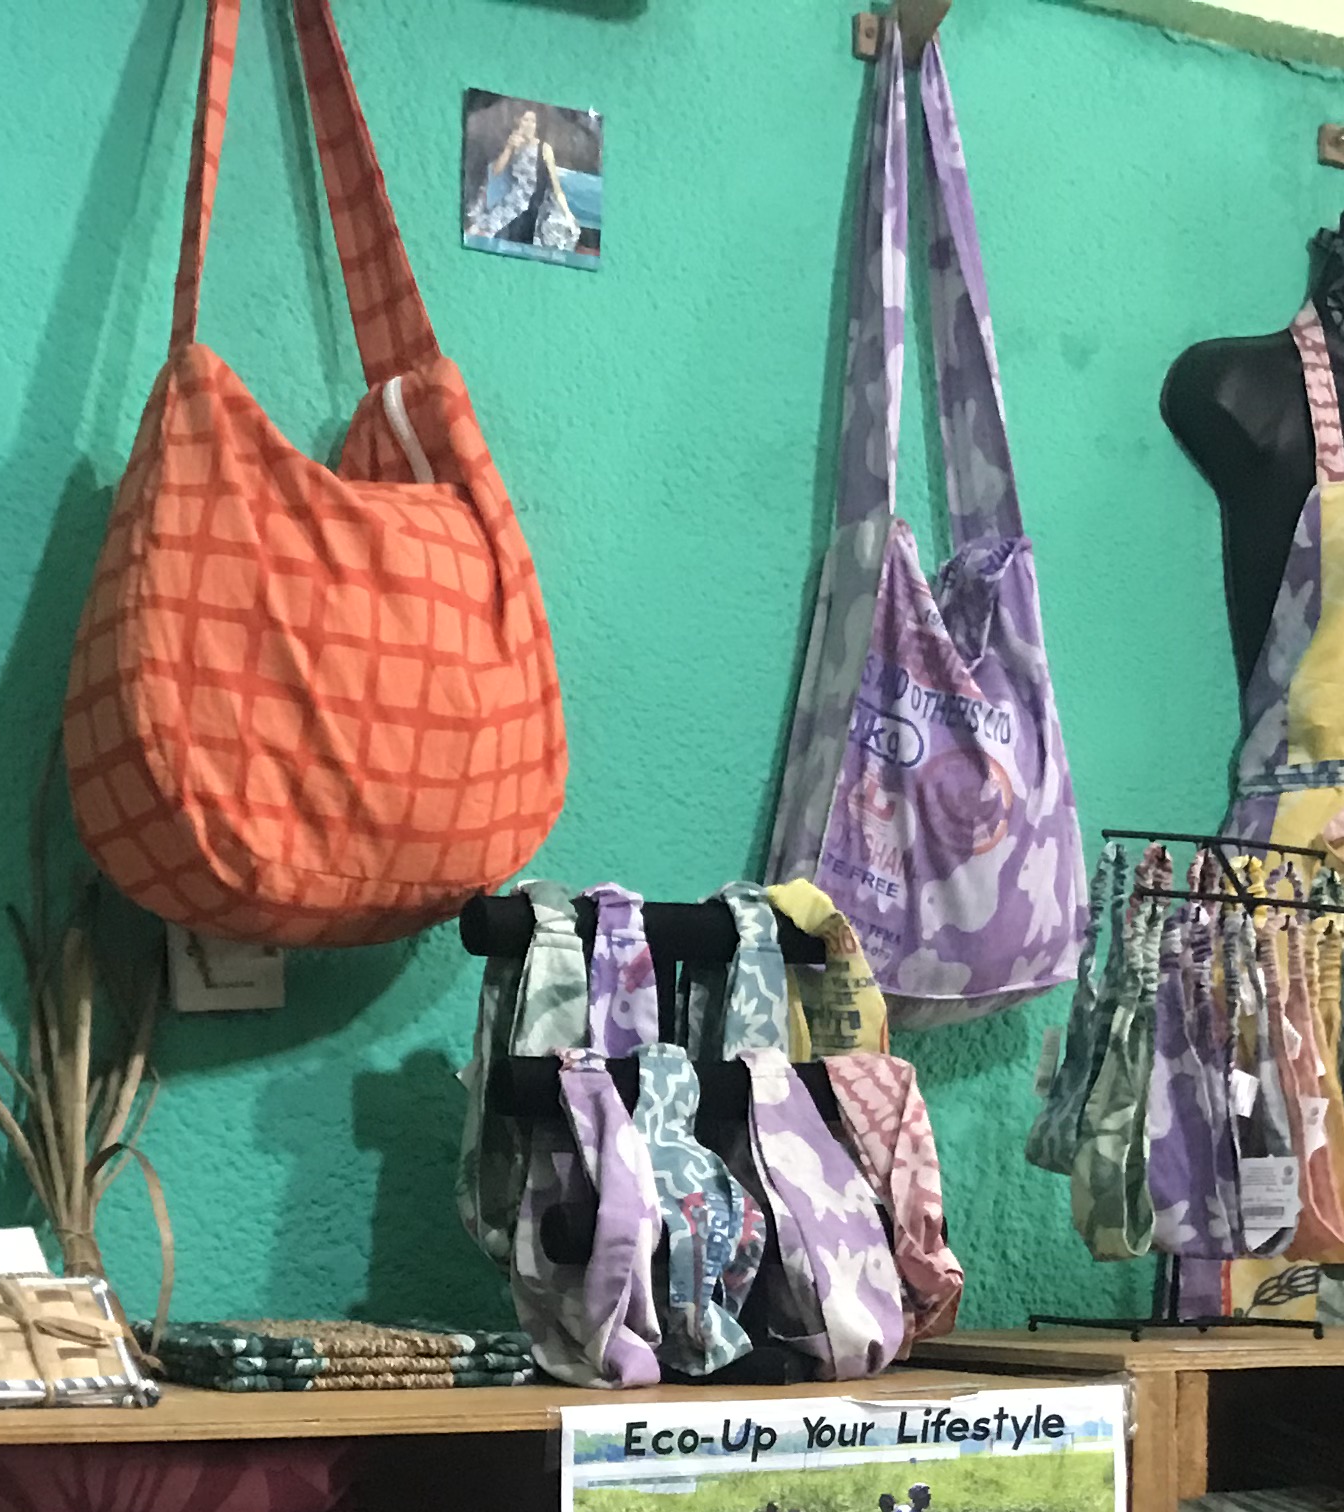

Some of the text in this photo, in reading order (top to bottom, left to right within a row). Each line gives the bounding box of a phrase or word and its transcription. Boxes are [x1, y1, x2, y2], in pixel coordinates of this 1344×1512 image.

[849, 866, 900, 900] FREE
[623, 1404, 1066, 1462] Eco-Up Your Lifestyle
